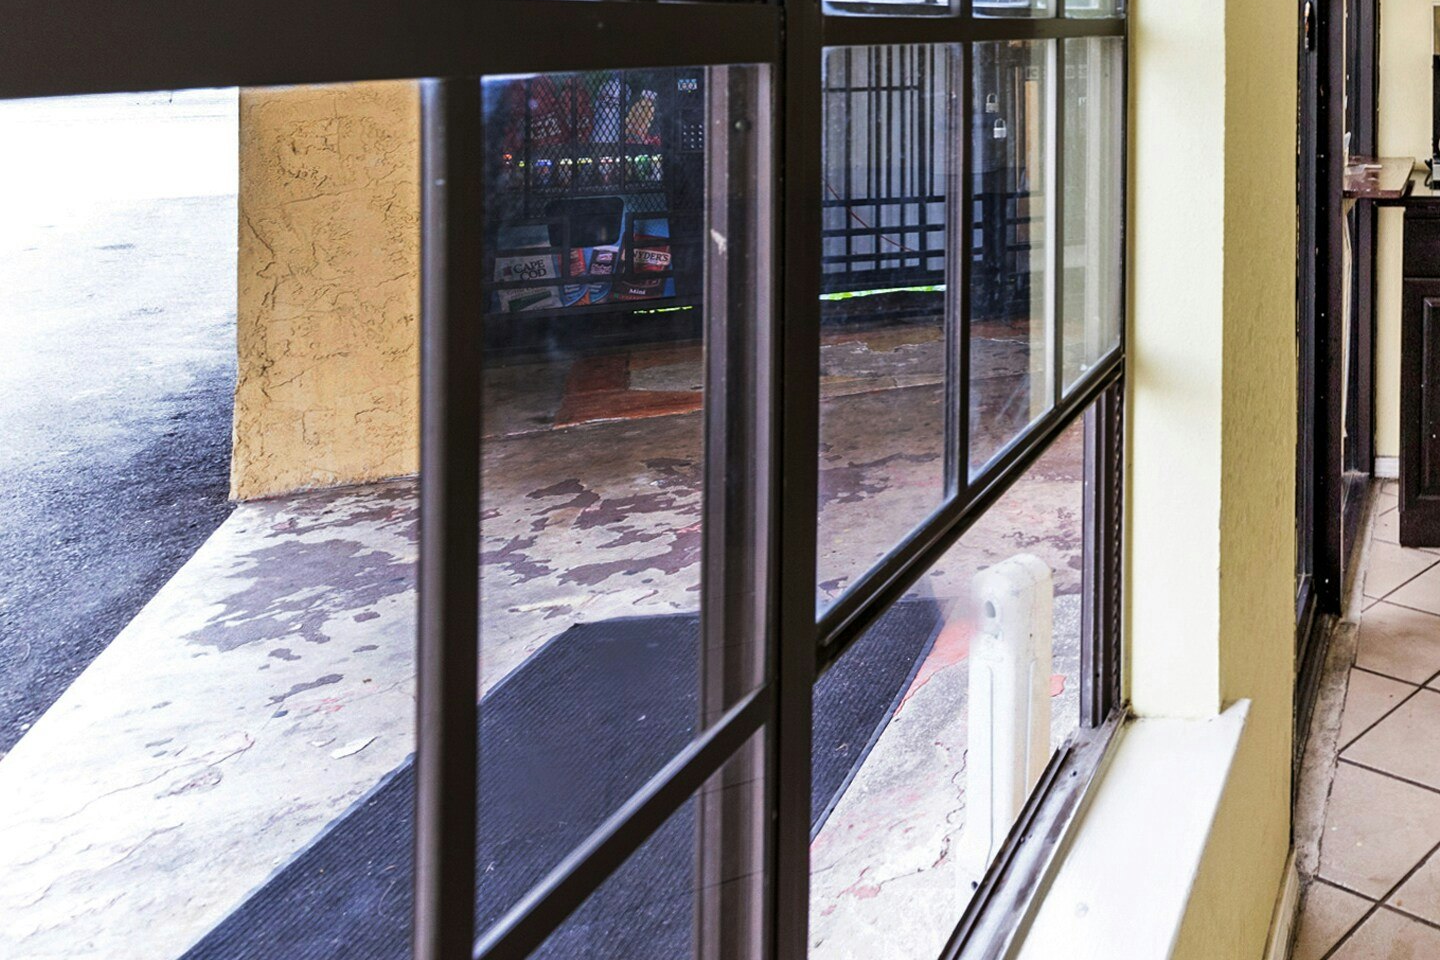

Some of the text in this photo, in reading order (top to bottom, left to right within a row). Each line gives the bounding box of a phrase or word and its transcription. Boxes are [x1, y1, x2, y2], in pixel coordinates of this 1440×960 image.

[633, 250, 669, 262] YDER'S
[513, 258, 545, 274] CAPE
[520, 268, 547, 281] COD
